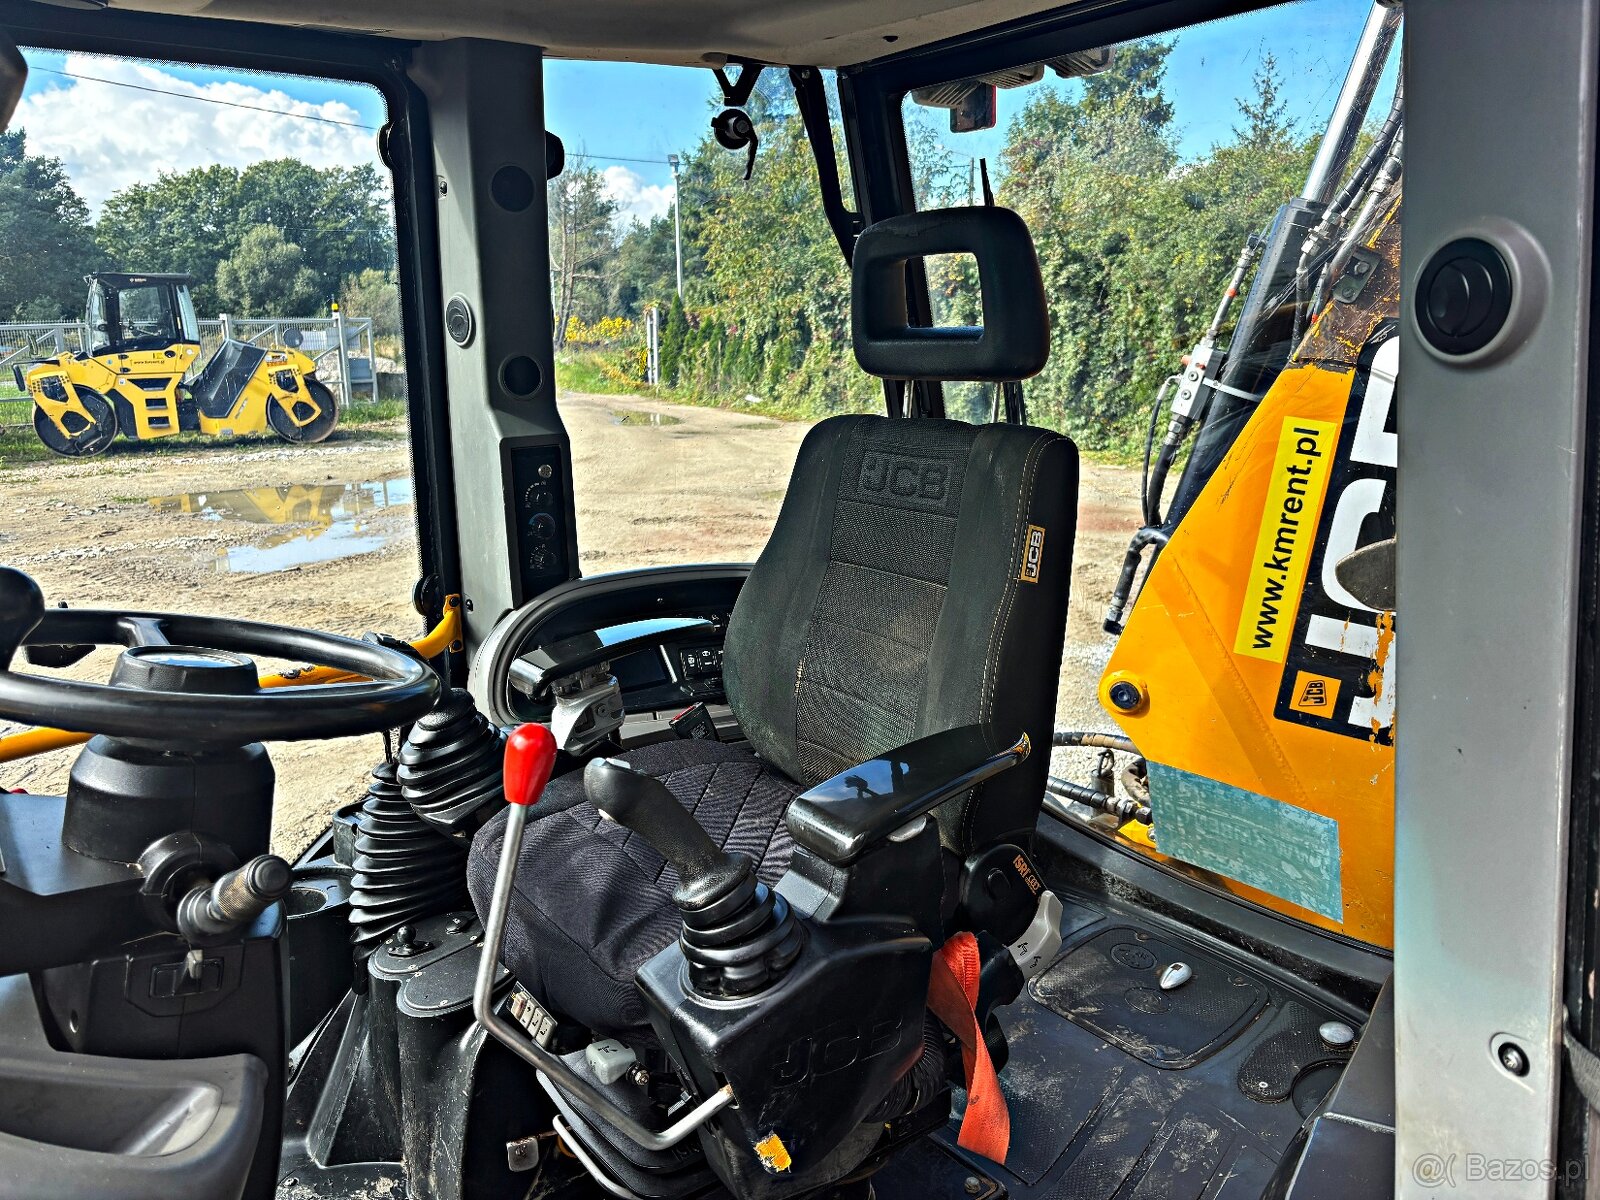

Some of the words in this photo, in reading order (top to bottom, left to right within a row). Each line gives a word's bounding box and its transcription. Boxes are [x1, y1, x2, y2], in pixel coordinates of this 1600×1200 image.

[861, 455, 949, 501] JCB
[1025, 530, 1042, 578] JCB
[1252, 427, 1322, 649] www.kmrent.pl
[1302, 681, 1325, 705] JCB
[1013, 854, 1031, 879] ISRI
